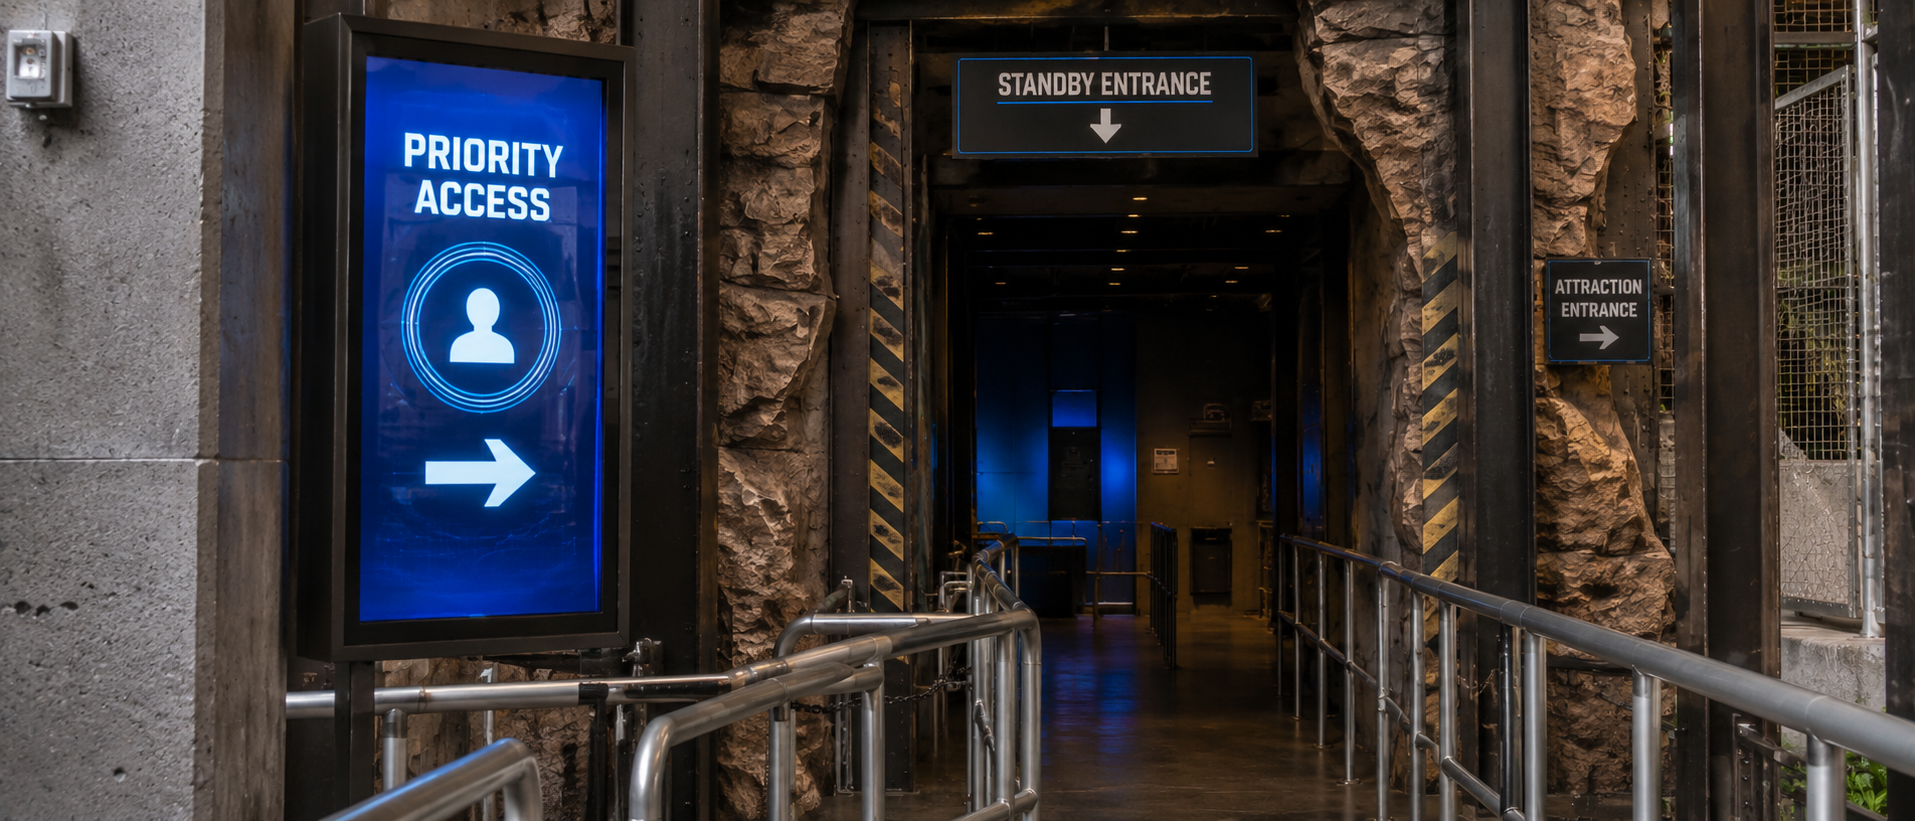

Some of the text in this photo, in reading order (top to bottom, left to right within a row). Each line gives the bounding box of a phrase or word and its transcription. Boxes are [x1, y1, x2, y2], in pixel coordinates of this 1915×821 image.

[998, 71, 1212, 96] STANDBY ENTRANCE
[404, 132, 563, 178] PRIORITY
[414, 179, 550, 221] ACCESS
[1554, 278, 1642, 295] ATTRACTION
[1561, 302, 1638, 318] ENTRANCE
